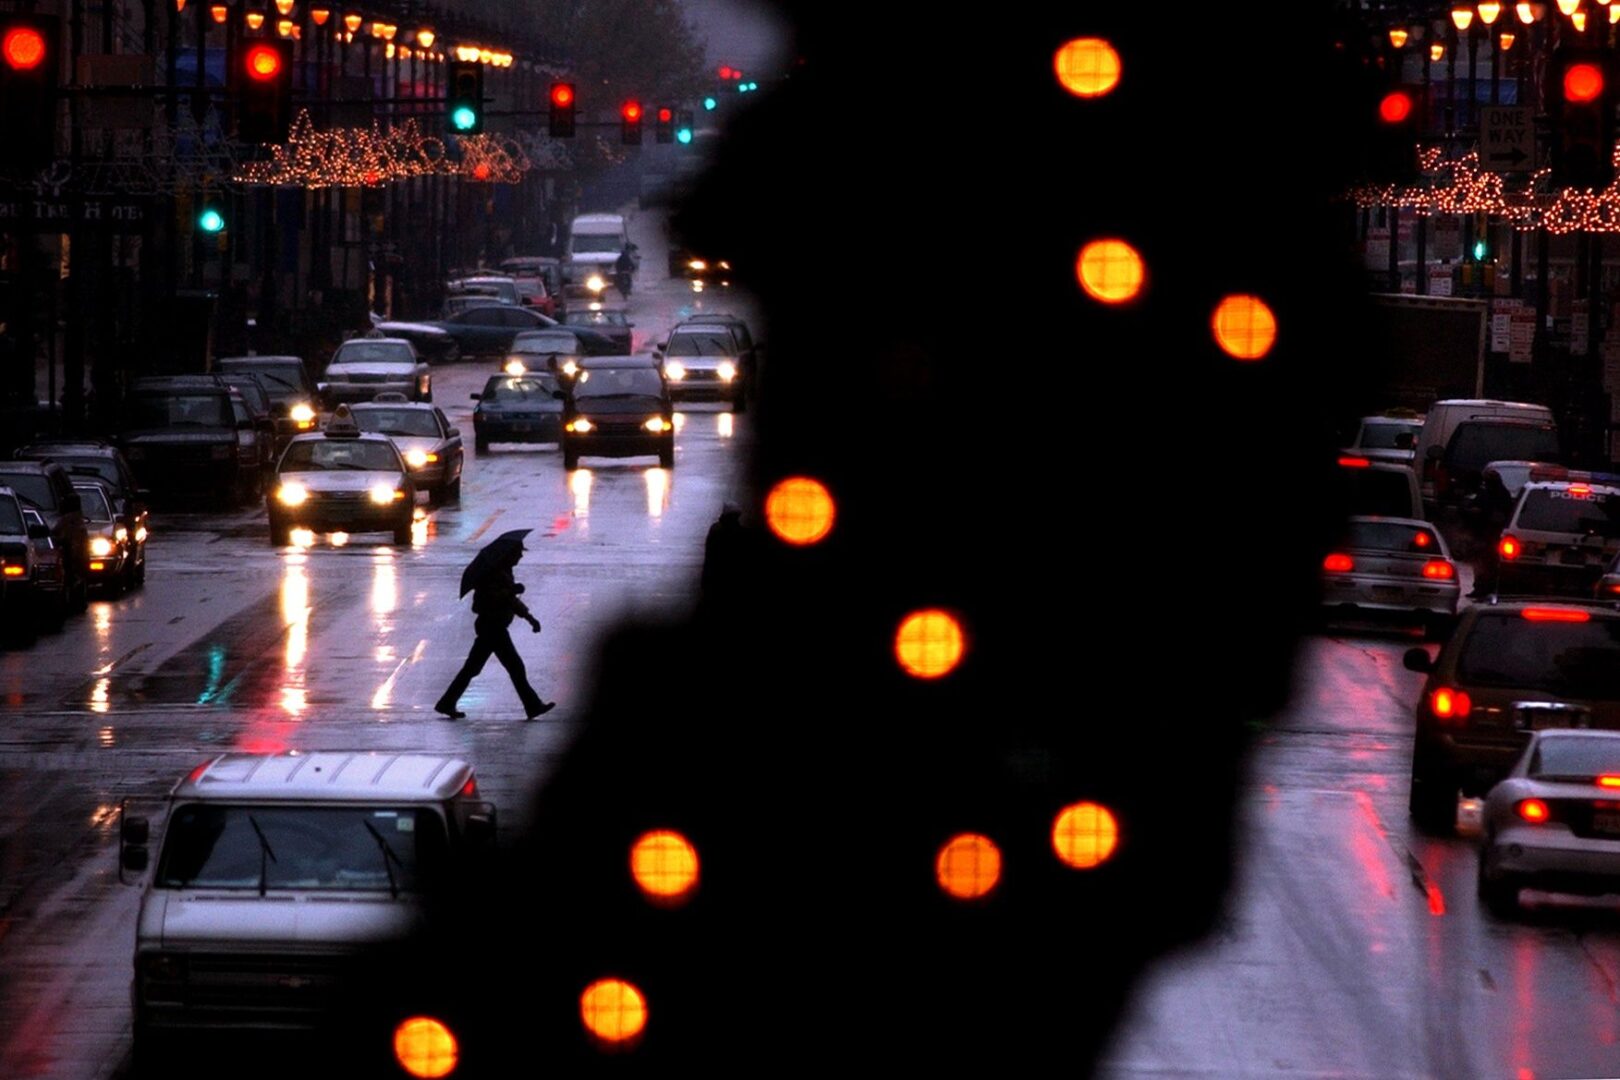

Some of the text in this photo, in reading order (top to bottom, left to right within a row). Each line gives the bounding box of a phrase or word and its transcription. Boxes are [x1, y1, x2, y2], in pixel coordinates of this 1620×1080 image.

[1490, 111, 1525, 126] ONE
[1489, 129, 1526, 143] WAY
[83, 200, 143, 220] HTE
[1549, 491, 1607, 504] POLICE
